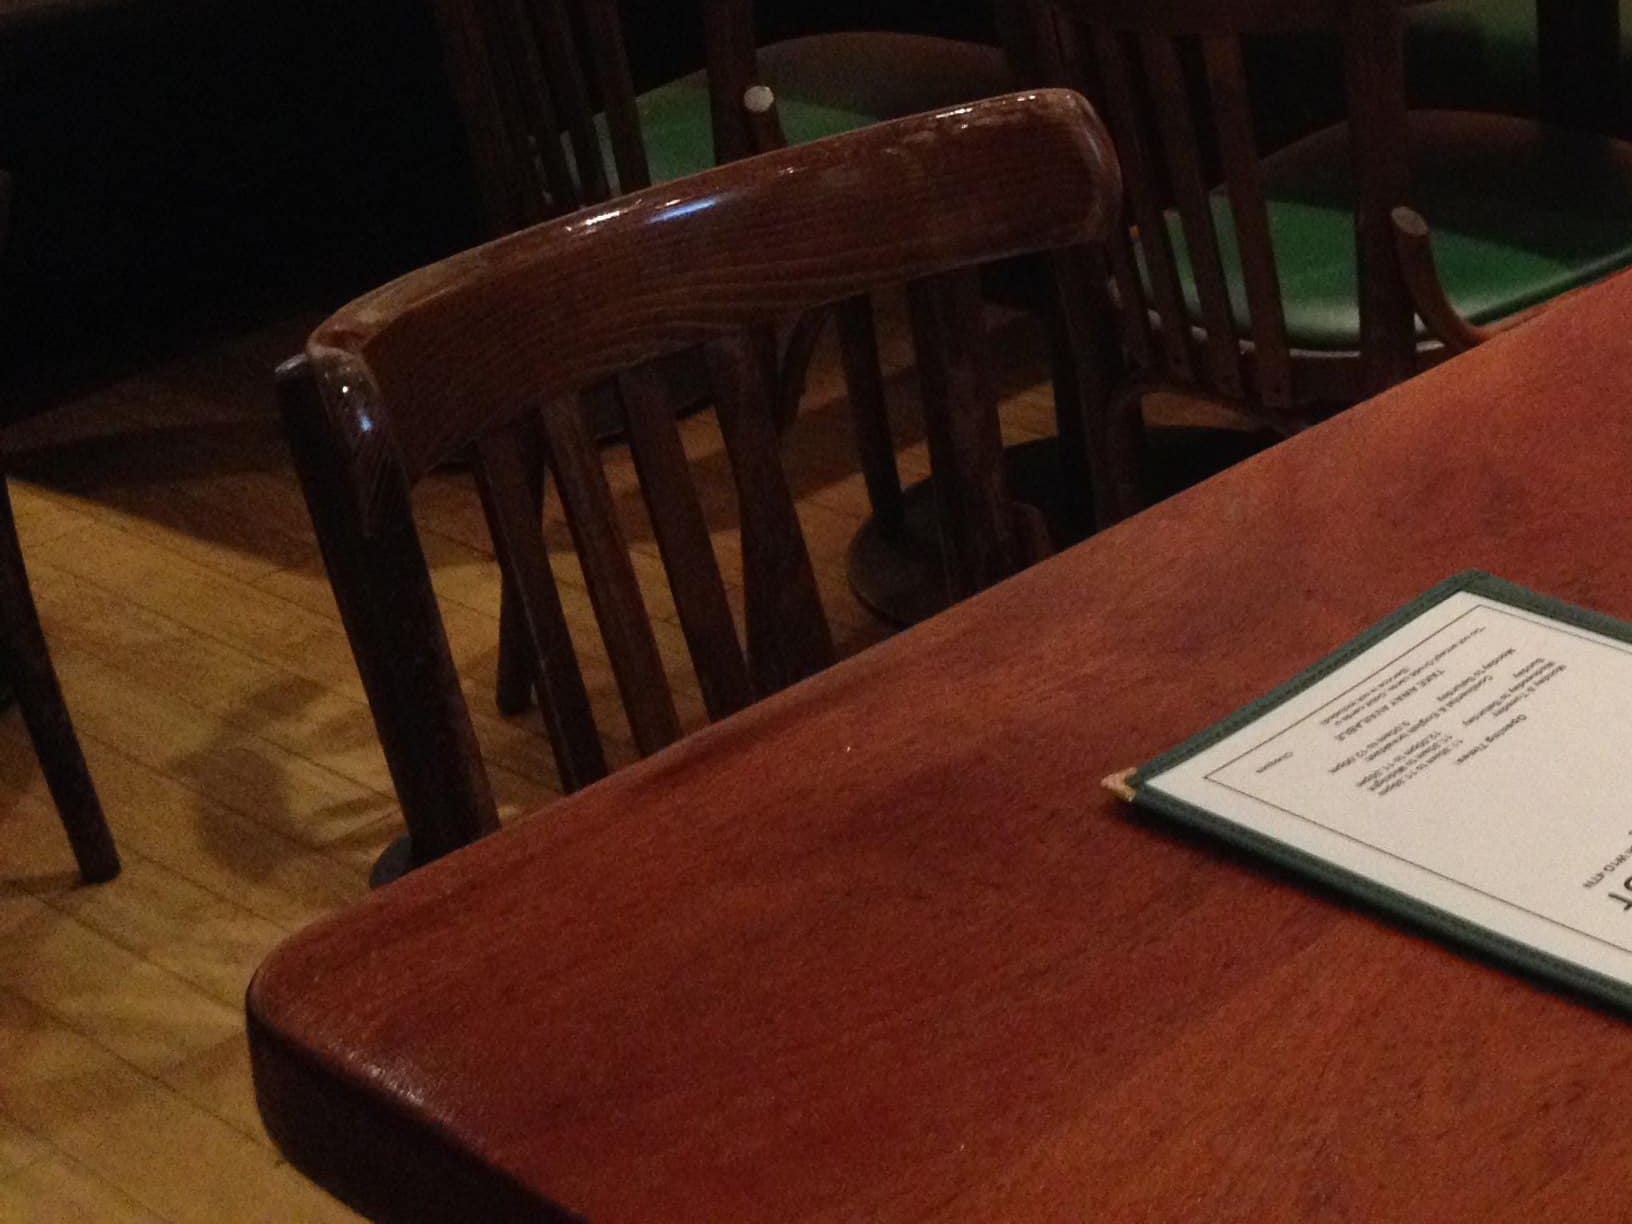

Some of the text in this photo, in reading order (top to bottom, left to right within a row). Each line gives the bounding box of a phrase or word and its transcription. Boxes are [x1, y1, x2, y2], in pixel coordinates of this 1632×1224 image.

[1482, 648, 1517, 670] Monday
[1513, 658, 1546, 679] Sunday
[1416, 670, 1446, 688] TAKE
[1508, 661, 1556, 694] Wednesday
[1534, 665, 1567, 688] Monday
[1390, 686, 1419, 707] AWAY
[1437, 677, 1477, 703] Saturday
[1334, 705, 1390, 742] AVAILABLE
[1462, 700, 1503, 727] Saturday
[1485, 715, 1528, 744] Opening
